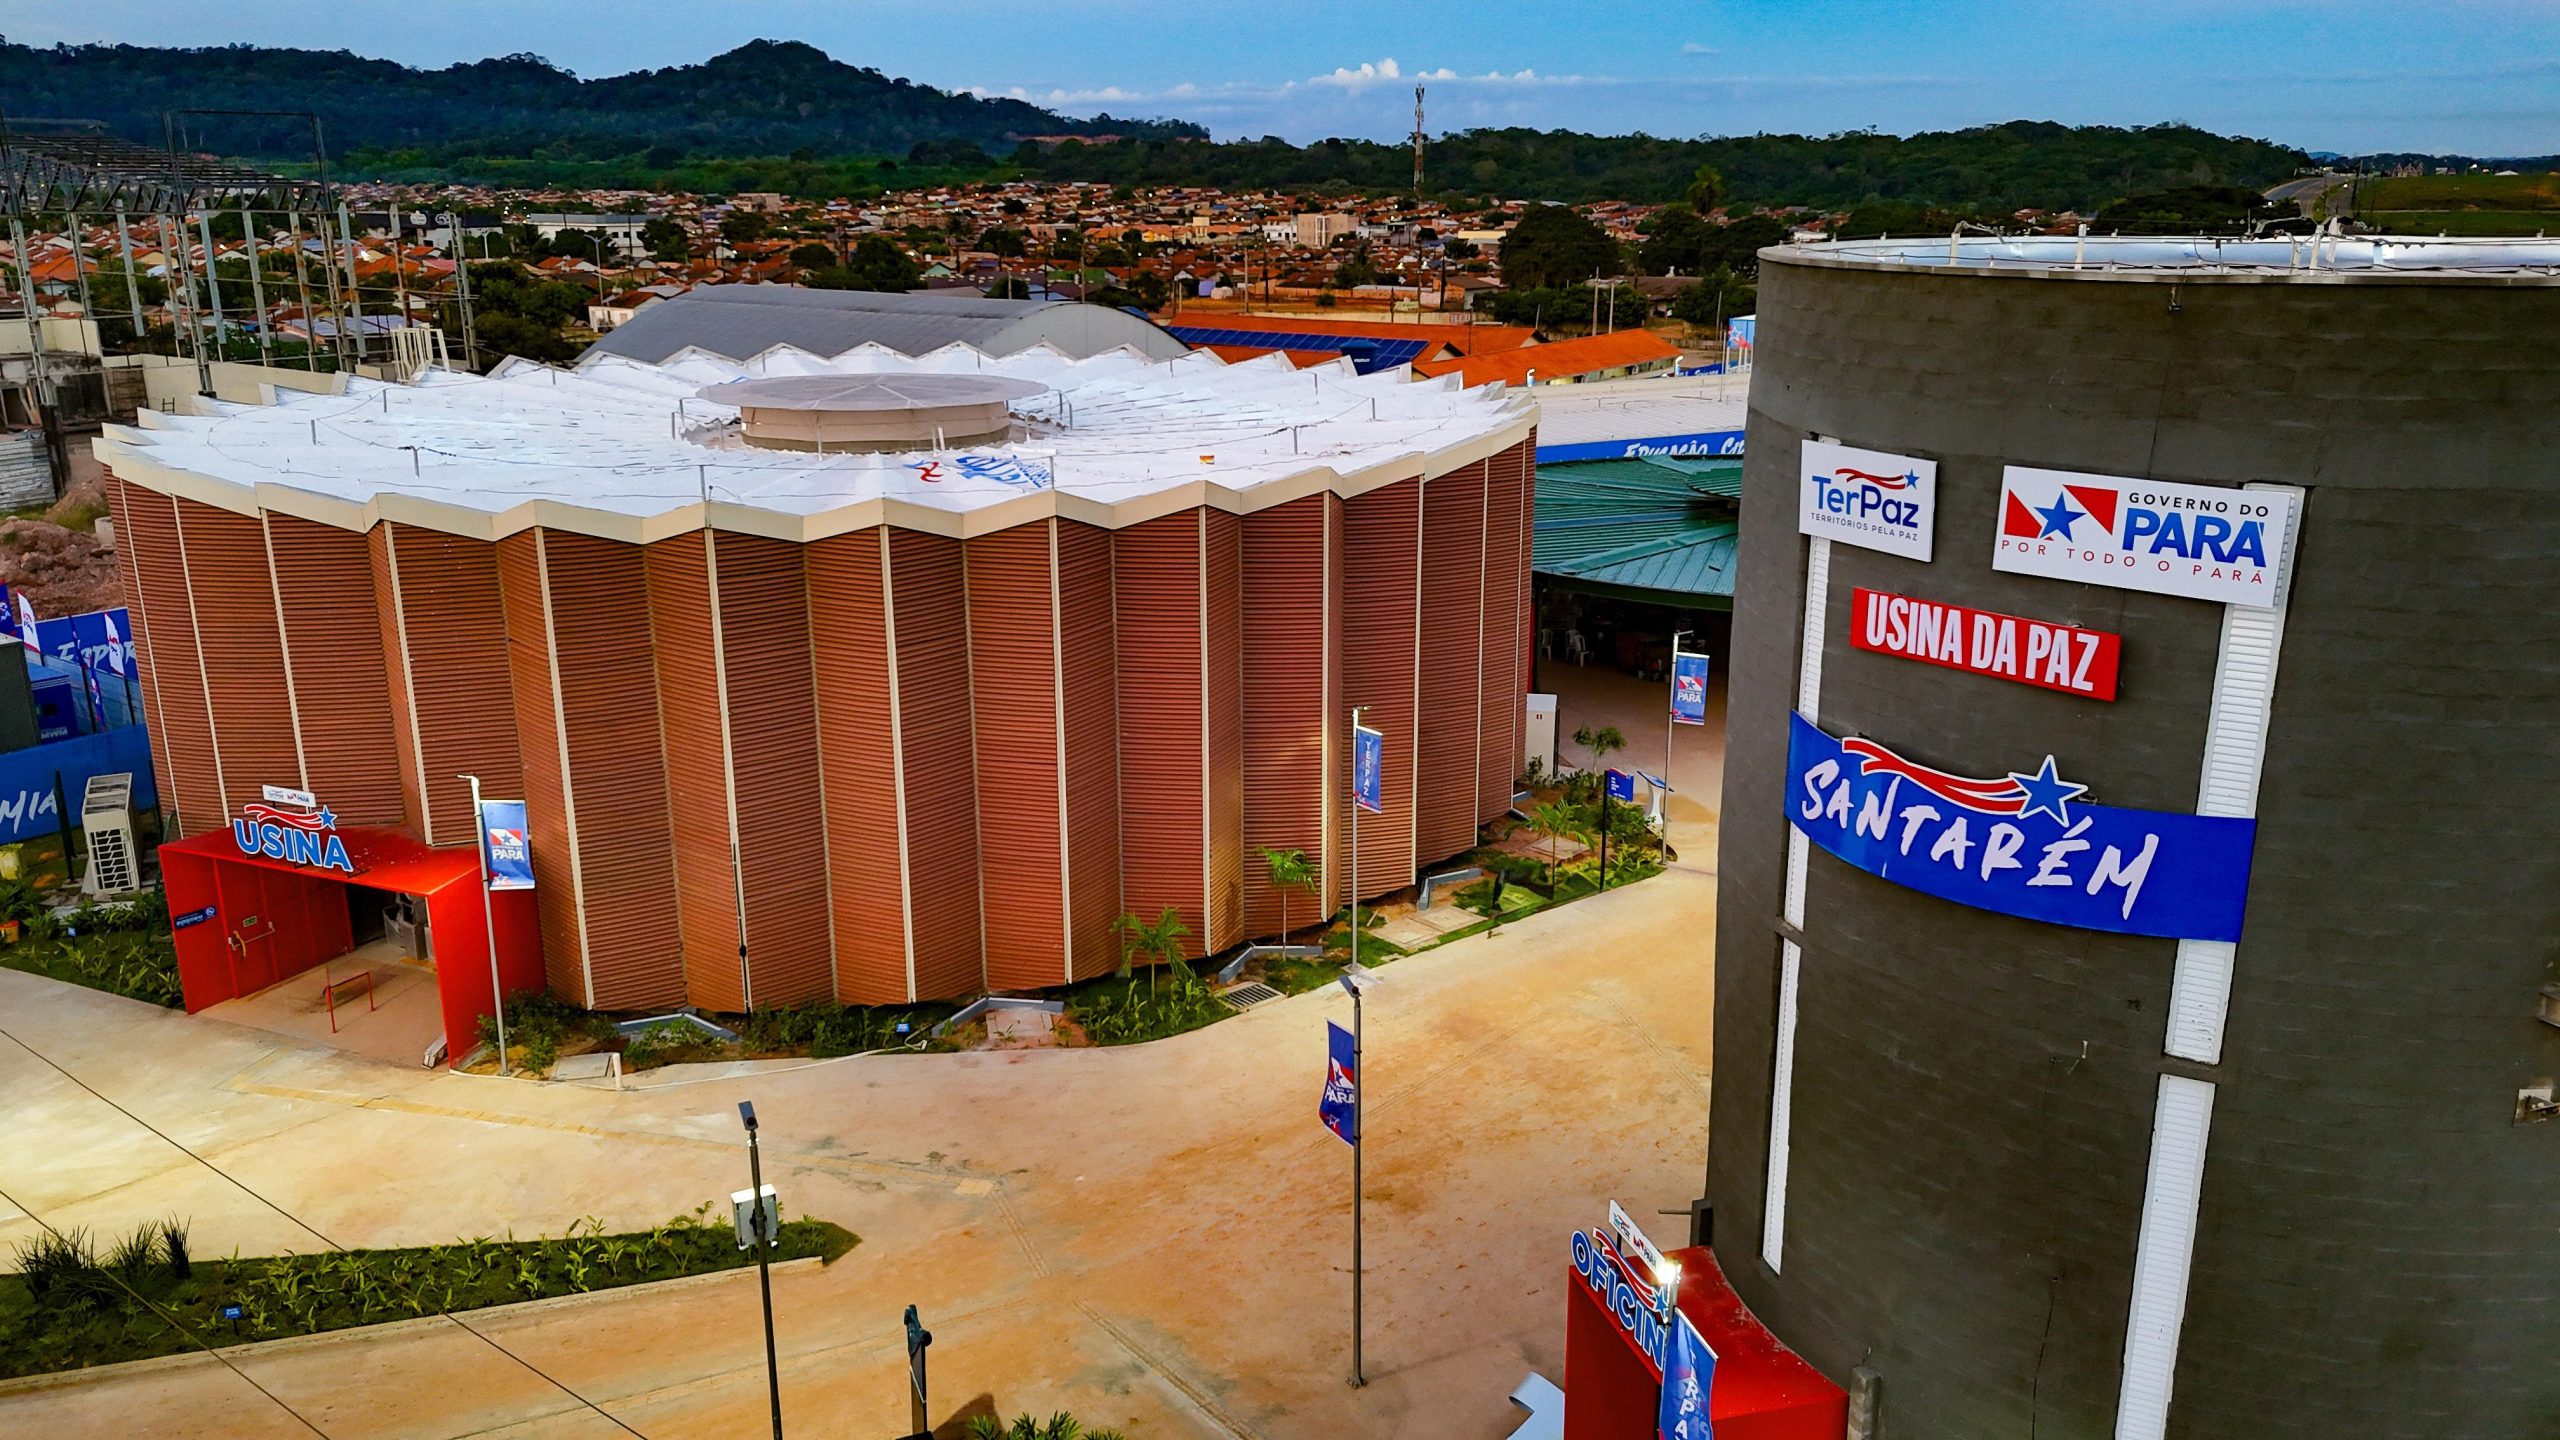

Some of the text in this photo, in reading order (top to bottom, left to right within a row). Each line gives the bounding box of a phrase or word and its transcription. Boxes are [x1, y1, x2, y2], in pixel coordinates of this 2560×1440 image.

[1811, 512, 1918, 541] TERRITÓRIOS PELA PAZ
[1812, 475, 1919, 529] TerPaz
[2129, 492, 2269, 517] GOVERNO DO
[2001, 540, 2262, 584] POR TODO O PARÁ
[2122, 507, 2267, 568] PARÁ
[1865, 592, 2100, 692] USINA DA PAZ
[1363, 740, 1371, 796] TERPAZ
[233, 817, 354, 872] USINA
[1802, 758, 2160, 921] SANTARÉM
[1571, 1230, 1666, 1373] OFICIN
